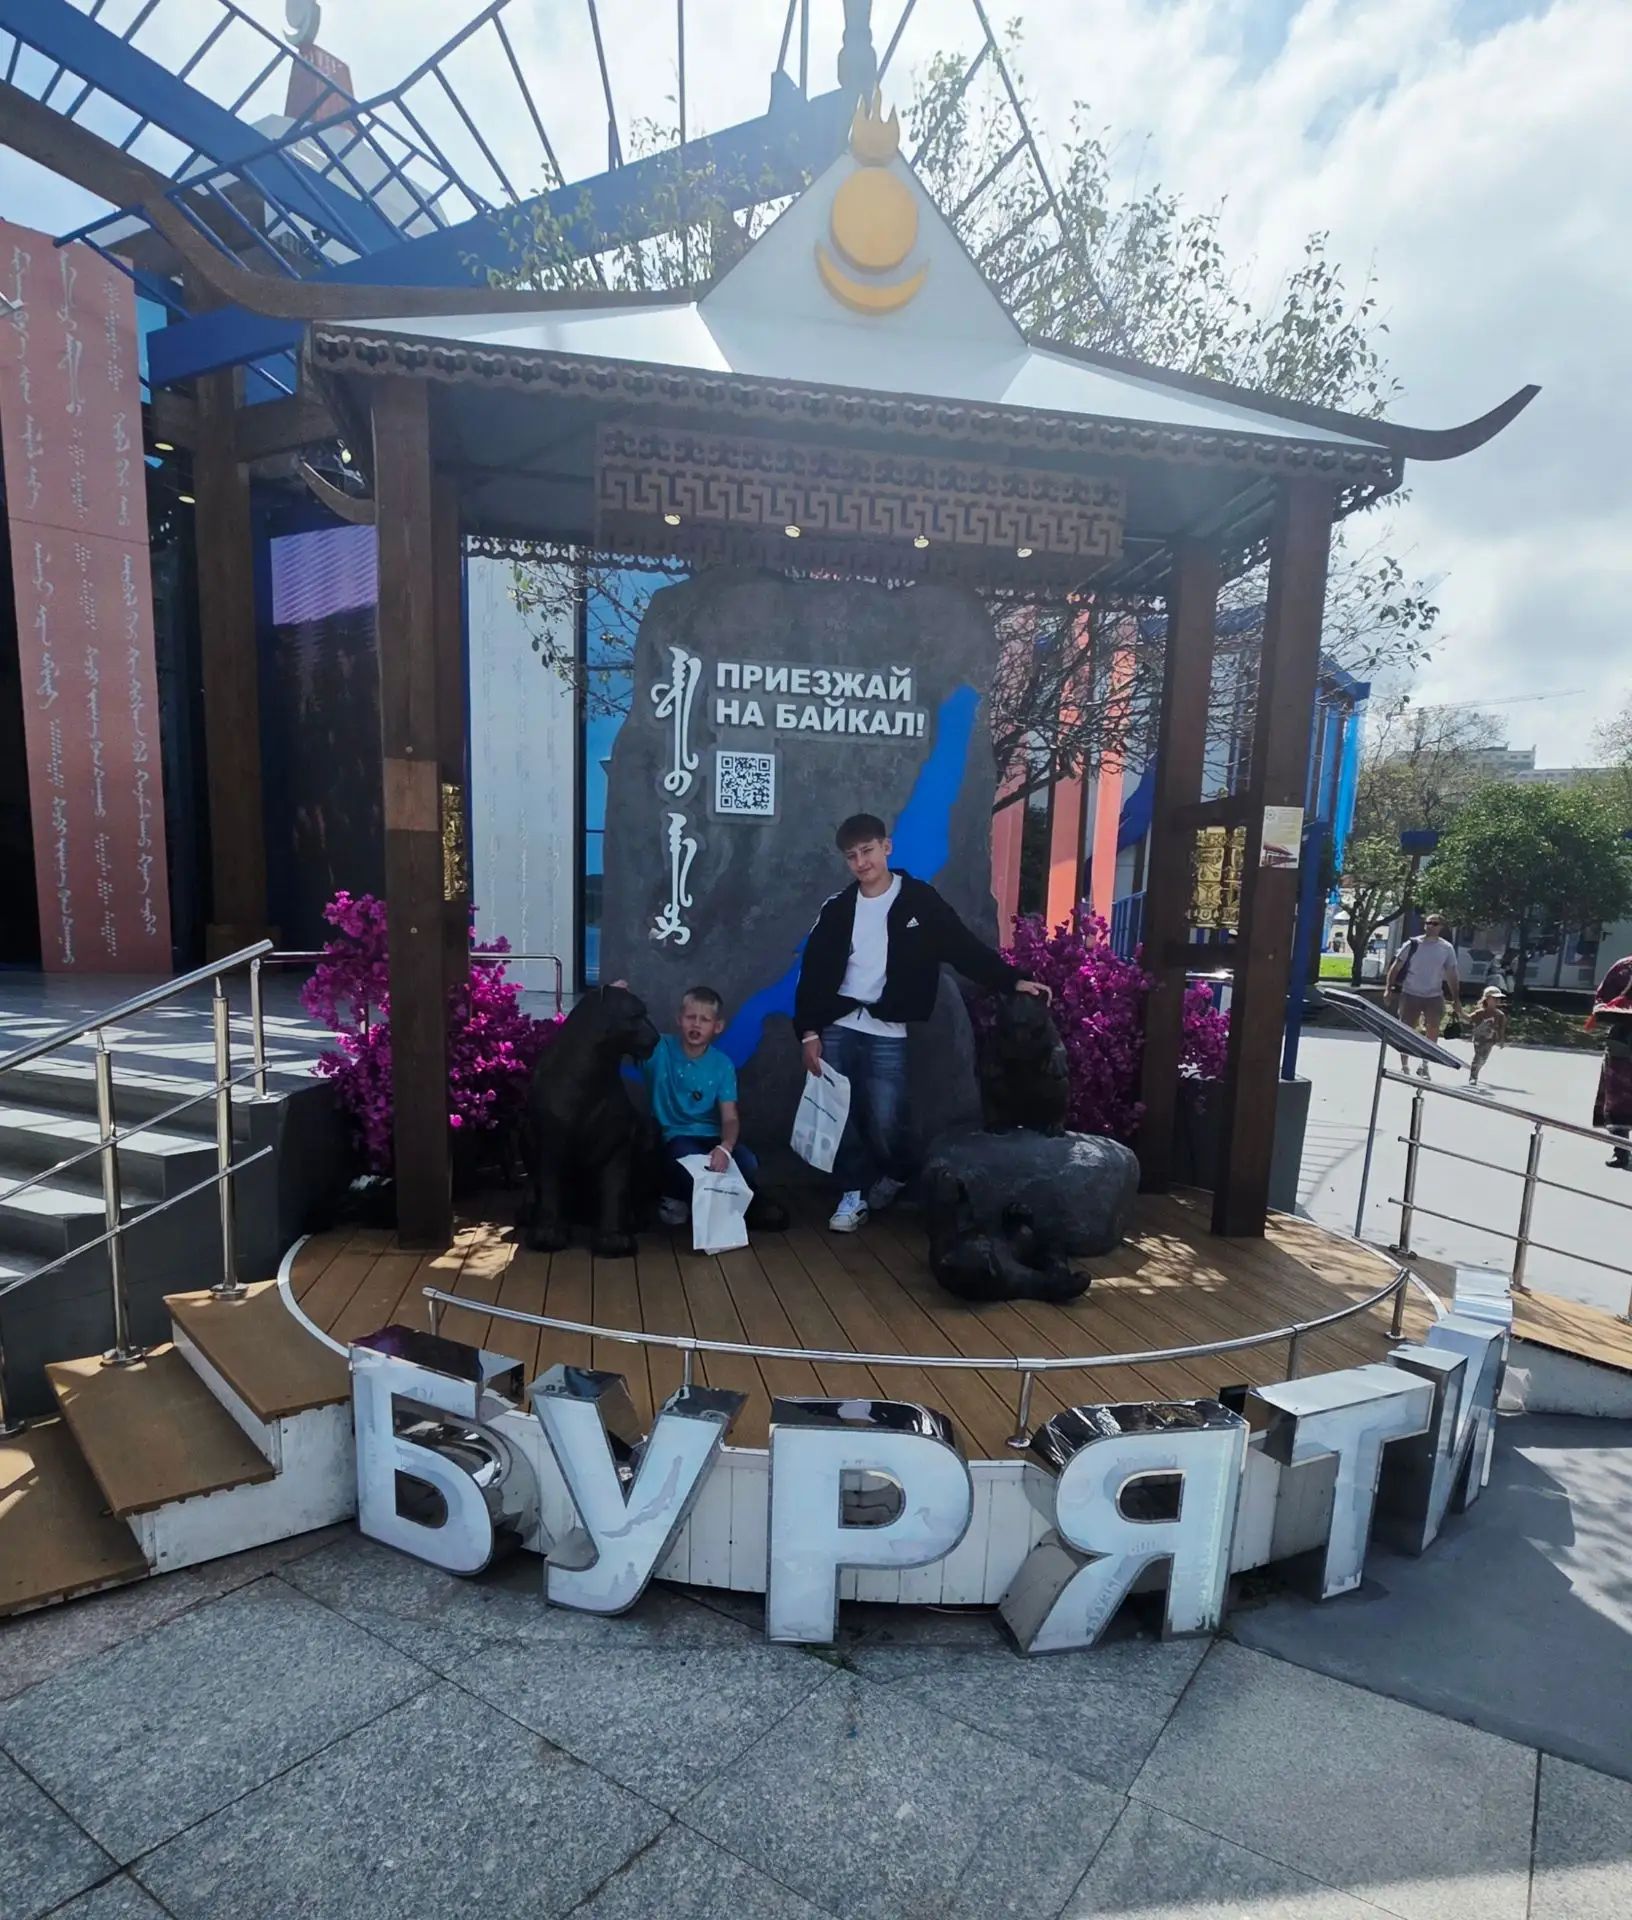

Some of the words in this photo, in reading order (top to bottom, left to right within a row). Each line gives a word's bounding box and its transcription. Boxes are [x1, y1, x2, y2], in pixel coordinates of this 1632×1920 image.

[716, 662, 912, 701] ПРИЕЗЖАЙ
[716, 698, 765, 728] НА
[775, 697, 925, 737] БАЙКАЛ!
